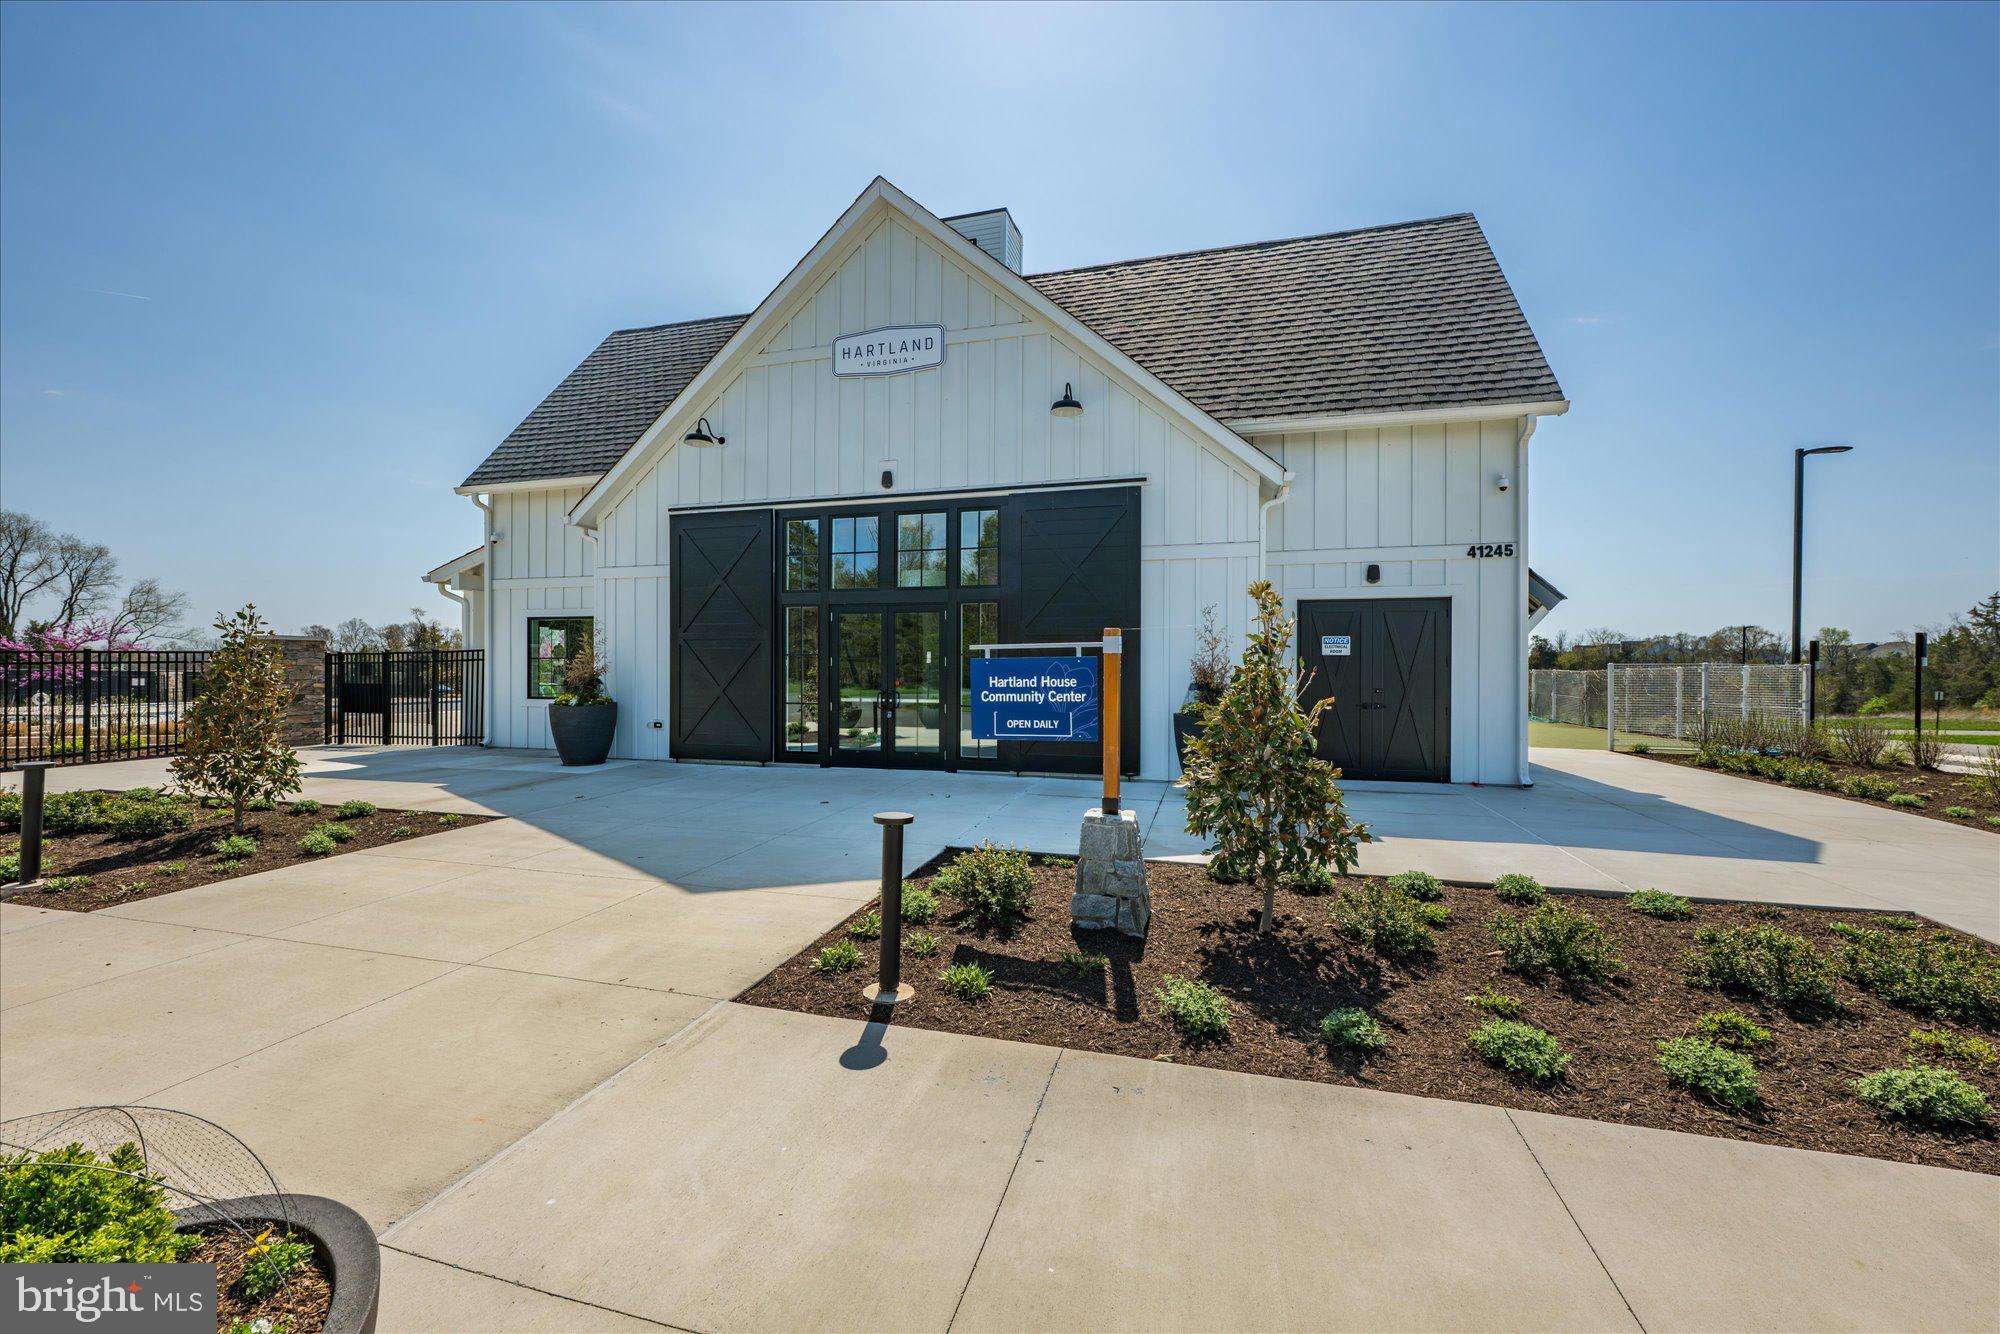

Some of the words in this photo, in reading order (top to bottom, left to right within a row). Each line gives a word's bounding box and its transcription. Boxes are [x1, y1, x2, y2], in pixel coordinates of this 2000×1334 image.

[842, 337, 933, 359] HARTLAND
[867, 357, 908, 367] VIRGINIA
[1467, 544, 1513, 558] 41245
[989, 676, 1037, 688] Hartland
[1041, 676, 1077, 688] House
[981, 691, 1045, 704] Community
[1048, 691, 1086, 702] Center
[1007, 720, 1031, 728] OPEN
[1034, 720, 1059, 728] DAILY
